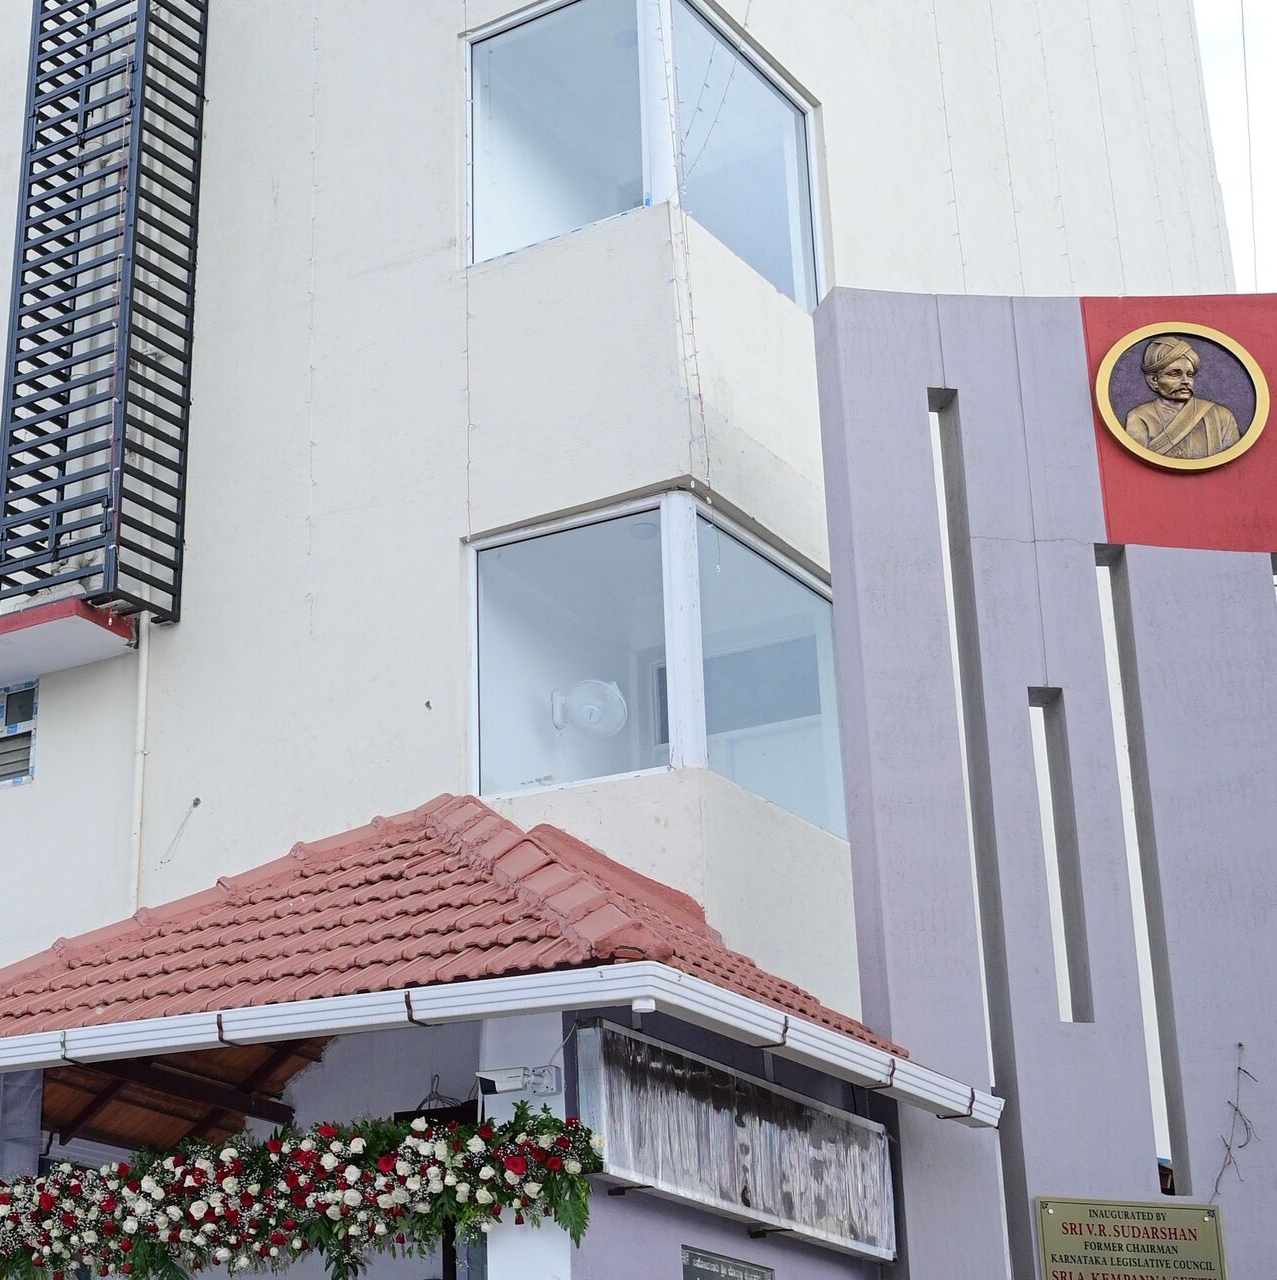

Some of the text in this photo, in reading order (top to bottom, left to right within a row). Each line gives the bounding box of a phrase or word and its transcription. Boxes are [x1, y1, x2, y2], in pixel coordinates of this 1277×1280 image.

[1089, 1209, 1166, 1221] INAUGURATED BY
[1062, 1222, 1082, 1236] SRI
[1084, 1242, 1178, 1254] FORMER CHAIRMAN
[1051, 1254, 1215, 1270] KARNATAKA LEGISLATIVE COUNCIL
